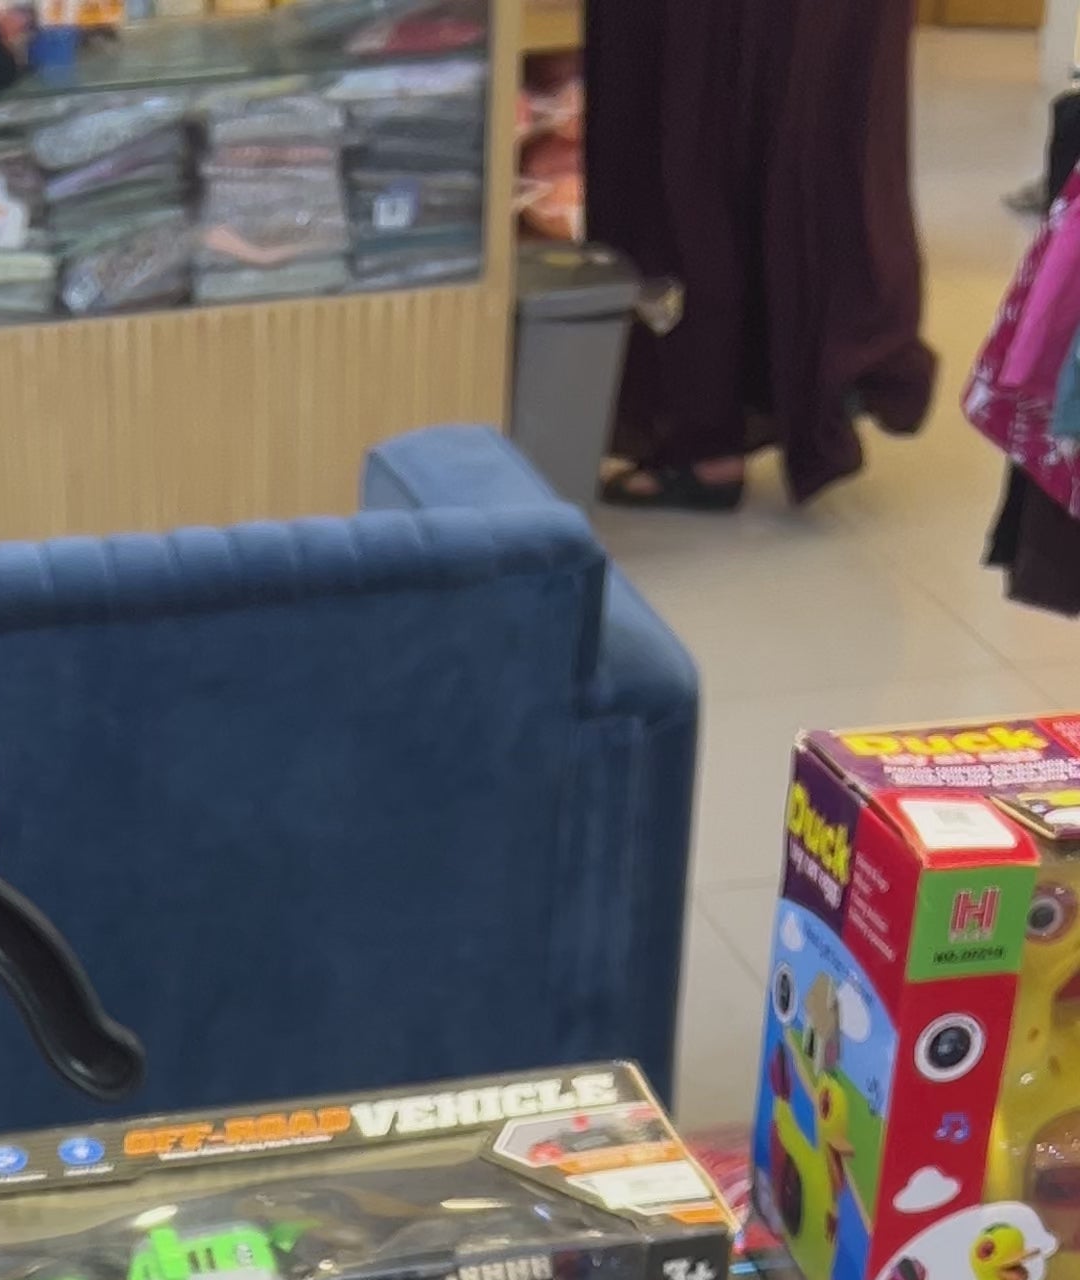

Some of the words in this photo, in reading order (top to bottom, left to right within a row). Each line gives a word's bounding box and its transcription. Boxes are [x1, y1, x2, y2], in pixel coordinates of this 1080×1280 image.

[841, 726, 1050, 757] Duck
[788, 782, 851, 885] Duck
[123, 1106, 352, 1155] OFF-ROAD
[351, 1073, 619, 1138] VEHICLE
